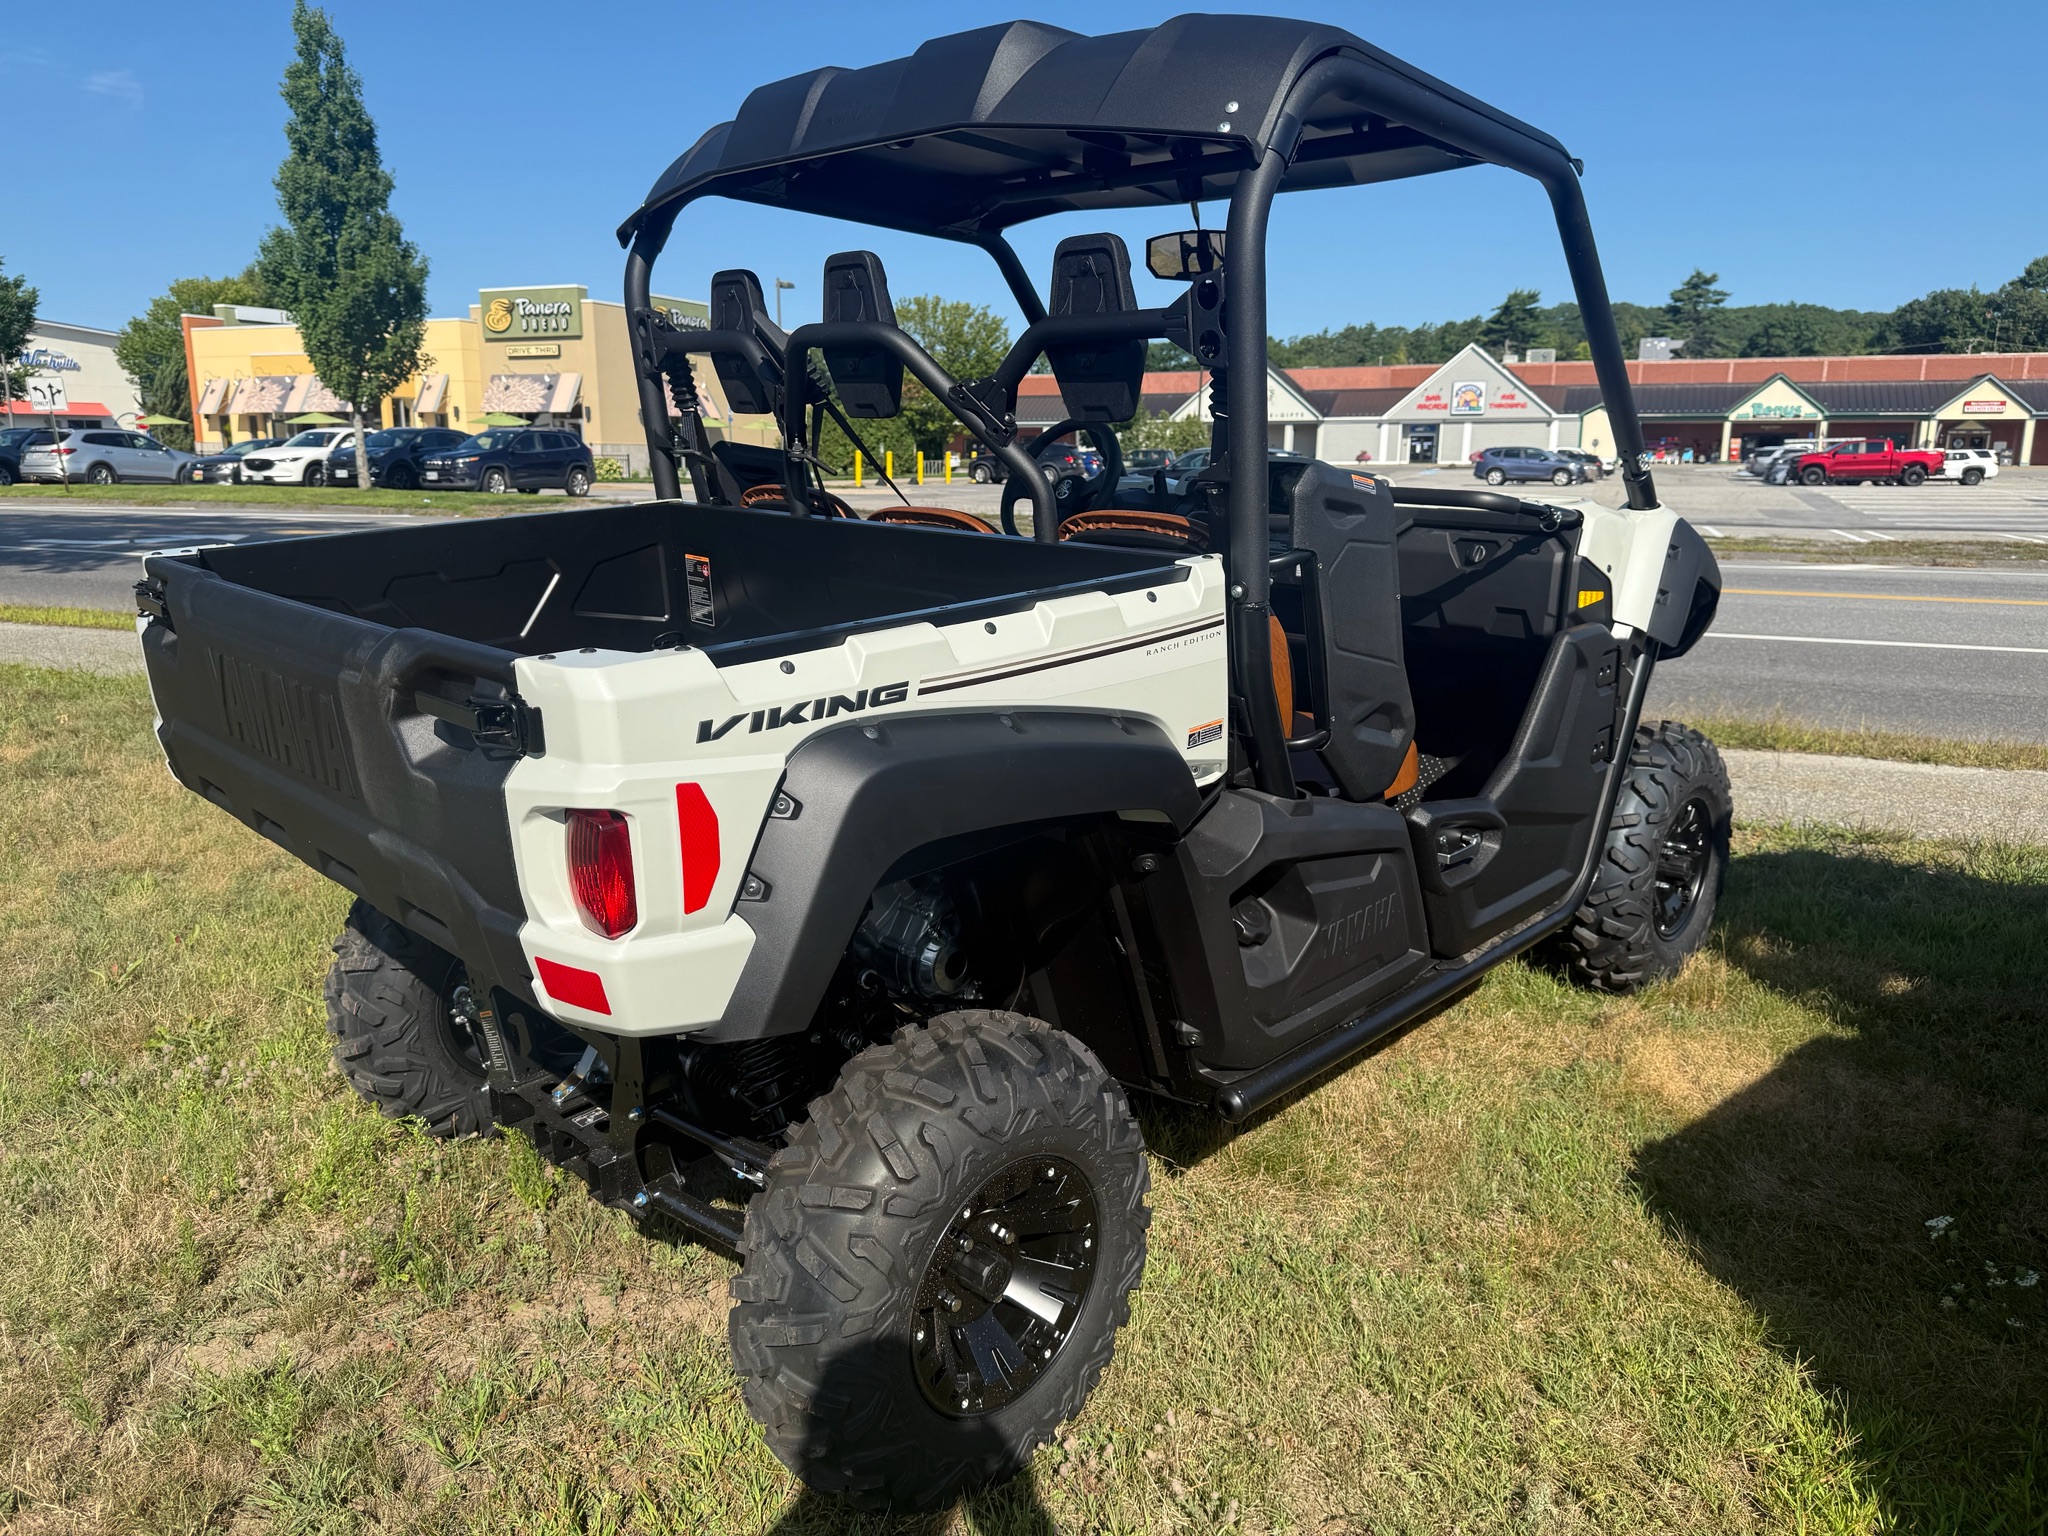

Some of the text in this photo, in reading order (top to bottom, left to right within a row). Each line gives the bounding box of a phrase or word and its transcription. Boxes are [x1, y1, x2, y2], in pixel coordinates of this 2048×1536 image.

[515, 297, 571, 316] Panera
[670, 308, 708, 328] Panera
[521, 317, 568, 331] BREAD
[535, 346, 557, 354] THRU
[1146, 630, 1222, 656] RANCH EDITION
[206, 647, 358, 800] YAMAHA
[696, 680, 910, 744] VIKING
[1320, 892, 1399, 959] YAMAHA
